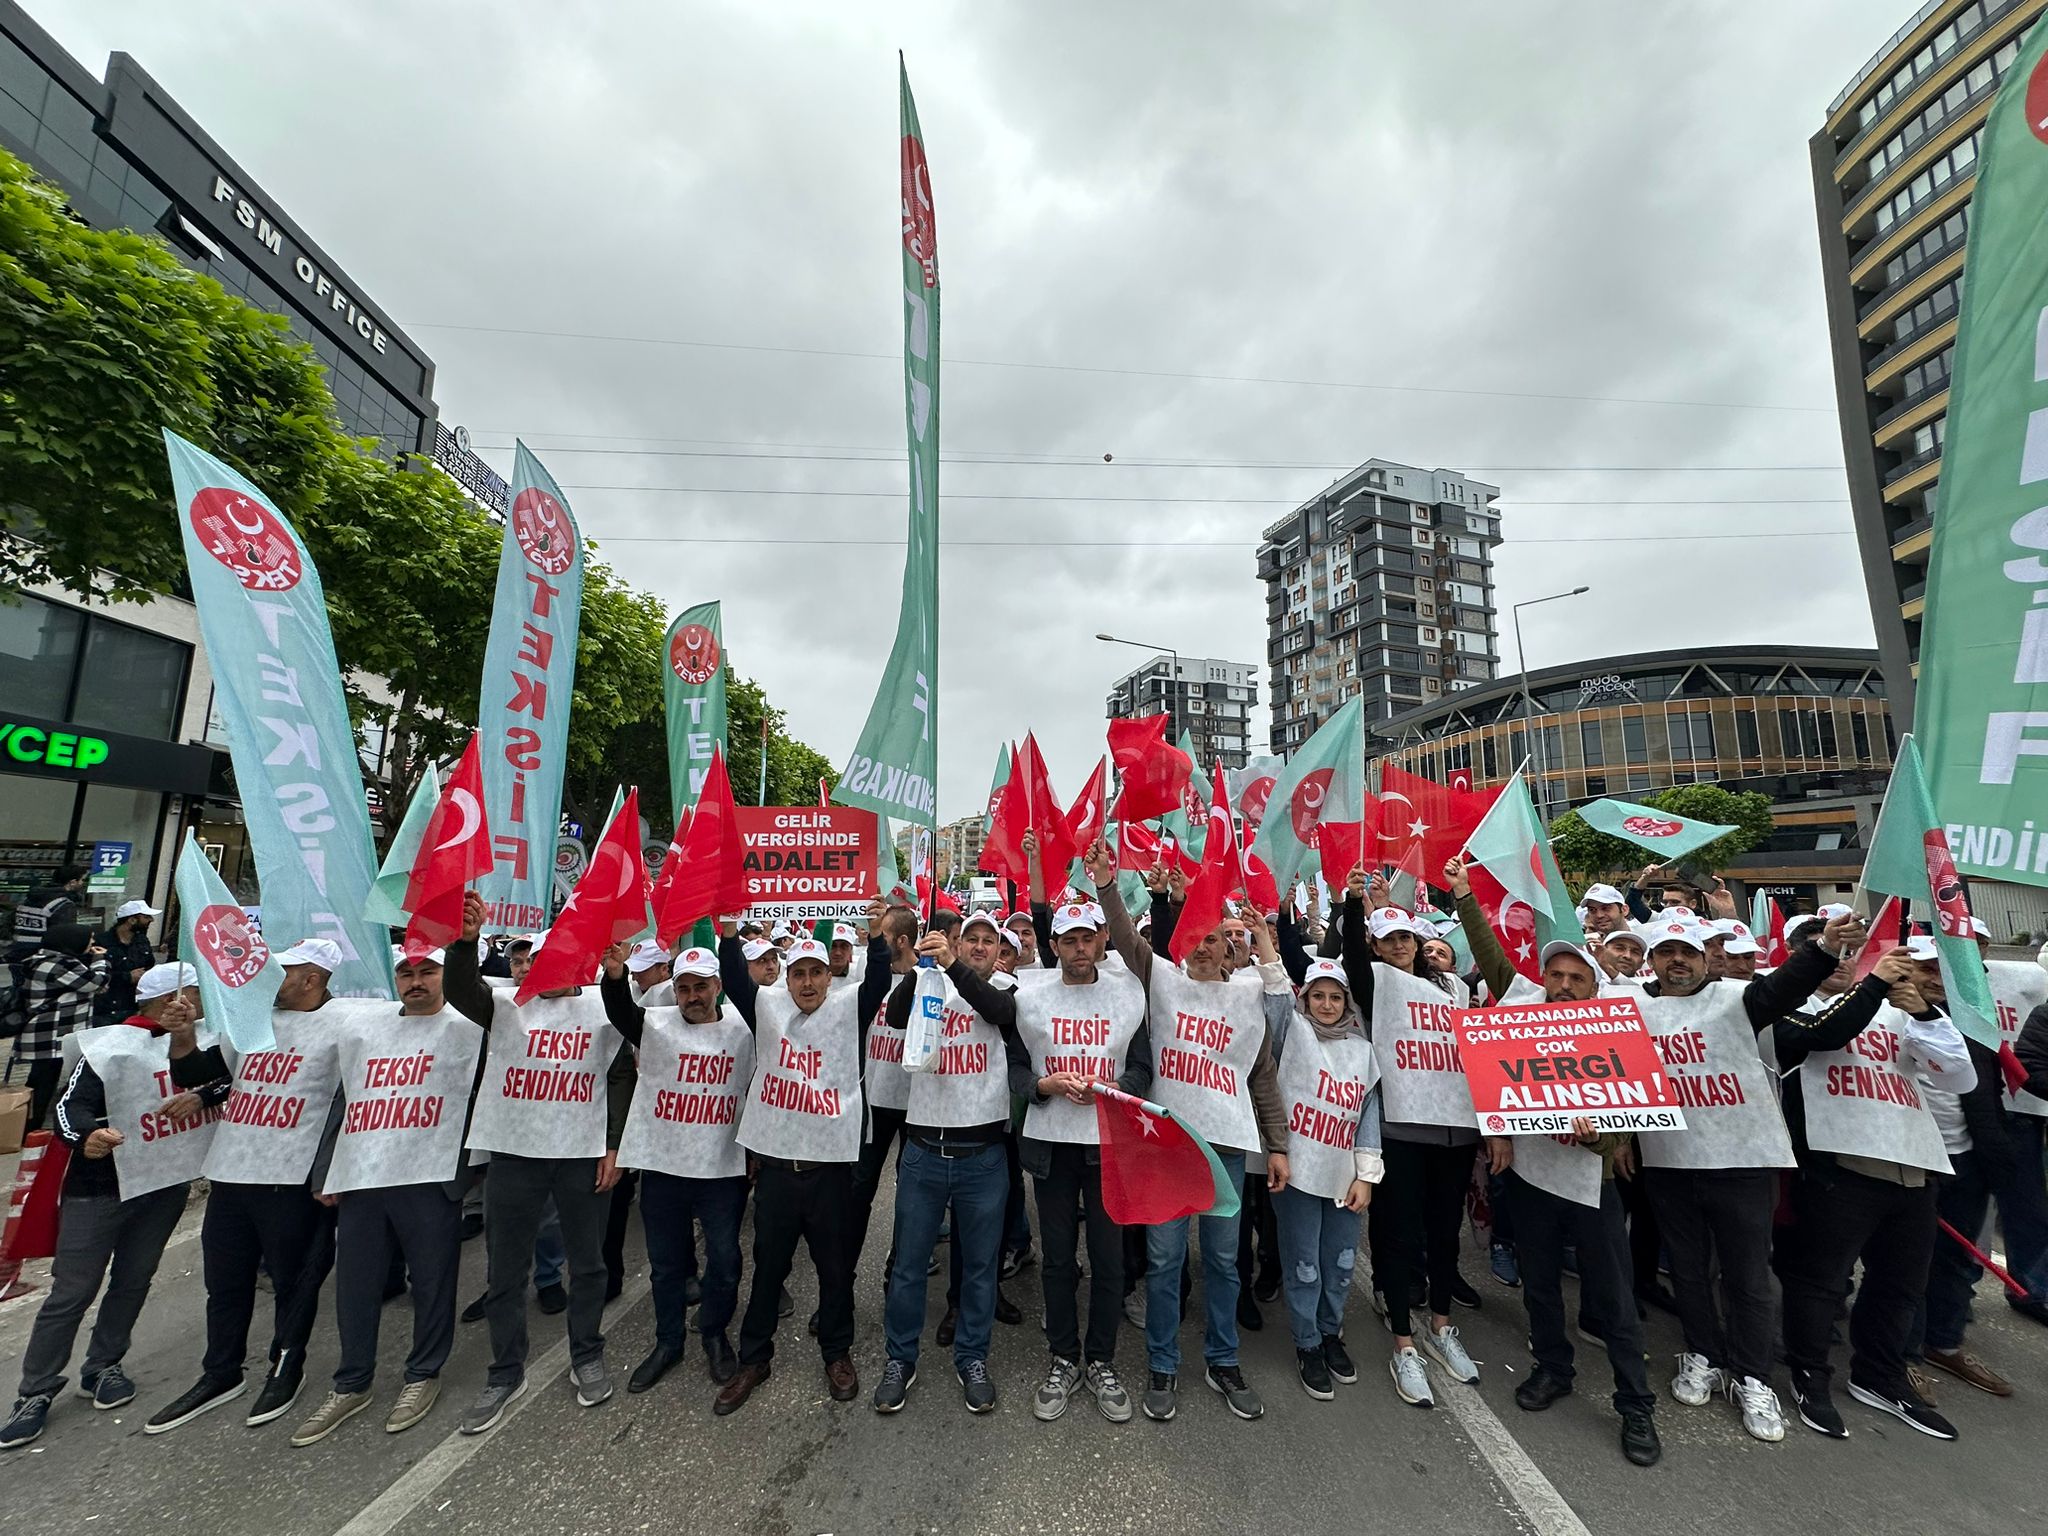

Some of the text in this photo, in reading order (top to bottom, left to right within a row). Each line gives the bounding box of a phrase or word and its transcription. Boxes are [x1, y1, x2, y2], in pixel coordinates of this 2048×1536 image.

[213, 176, 387, 356] FSM OFFICE
[673, 660, 716, 684] TEKSİF
[1581, 674, 1620, 688] mudo
[1581, 679, 1636, 695] concept
[0, 724, 109, 769] CEP
[774, 811, 832, 828] GELİR
[743, 830, 860, 847] VERGİSİNDE
[100, 853, 122, 867] 12
[743, 851, 860, 871] ADALET
[745, 904, 795, 919] TEKSİF
[799, 905, 867, 918] SENDİKAS
[1051, 1013, 1111, 1046] TEKSİF
[1175, 1011, 1234, 1054] TEKSİF
[1462, 1003, 1636, 1028] AZ KAZANADAN AZ
[1466, 1019, 1641, 1045] ÇOK KAZANANDAN
[526, 1025, 592, 1061] TEKSİF
[1535, 1040, 1579, 1056] ÇOK
[238, 1047, 304, 1085] TEKSİF
[364, 1049, 435, 1089] TEKSİF
[502, 1063, 596, 1103] SENDİKASI
[676, 1049, 735, 1085] TEKSİF
[1159, 1046, 1237, 1097] SENDİKASI
[1498, 1047, 1627, 1083] VERGİ
[654, 1087, 738, 1125] SENDİKASI
[760, 1072, 841, 1117] SENDİKASI
[1316, 1068, 1366, 1113] TEKSİF
[344, 1090, 445, 1135] SENDİKASI
[1507, 1114, 1569, 1132] TEKSİF
